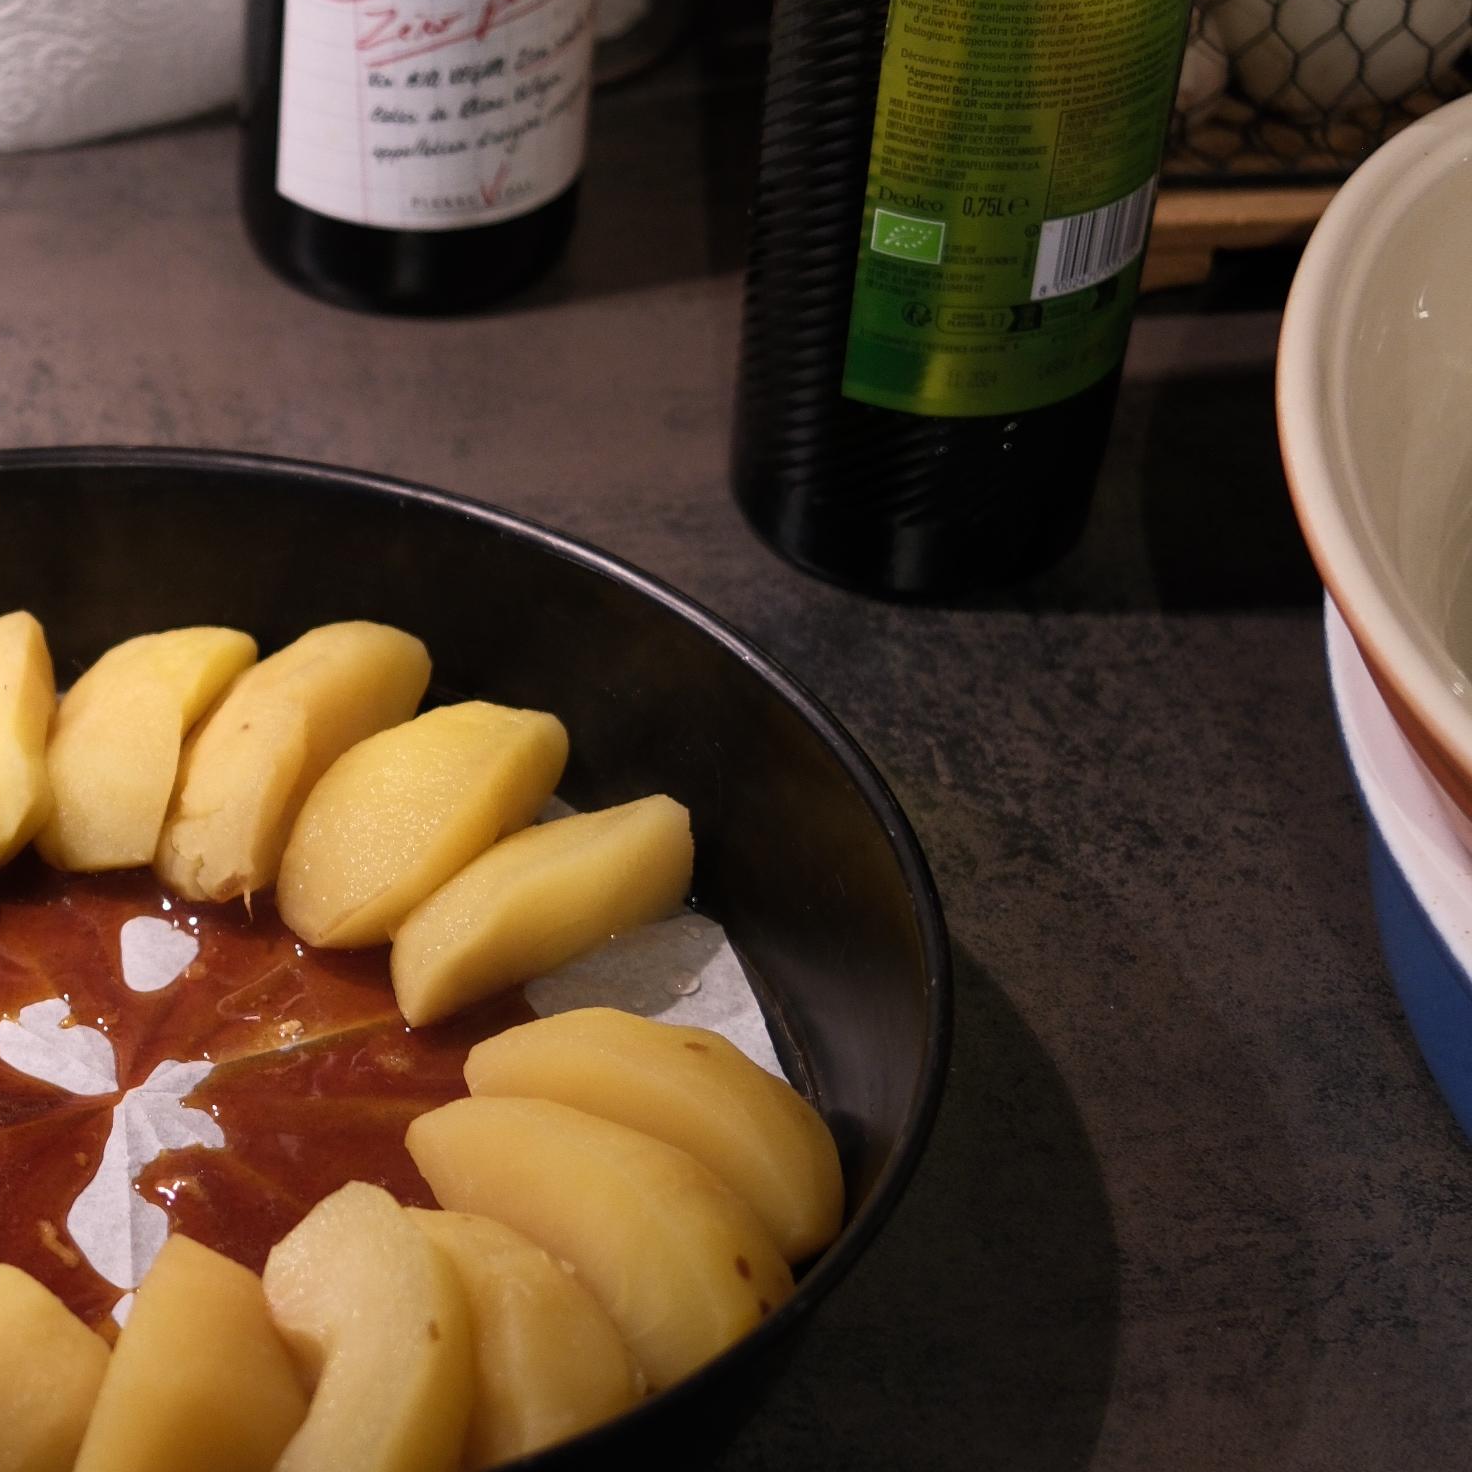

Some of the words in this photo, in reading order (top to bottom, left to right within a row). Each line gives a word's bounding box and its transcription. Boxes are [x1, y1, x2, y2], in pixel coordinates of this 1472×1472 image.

[931, 5, 958, 18] Extra
[979, 2, 998, 11] son
[1059, 1, 1082, 13] pour
[903, 23, 956, 43] biologique,
[958, 37, 1009, 49] apportera
[1011, 39, 1024, 48] de
[912, 15, 945, 29] d'olive
[947, 20, 979, 35] Vierge
[980, 24, 1009, 36] Extra
[1010, 25, 1056, 38] Carapelli
[1058, 24, 1075, 35] Bio
[901, 47, 951, 68] Découvrez
[953, 61, 981, 71] notre
[907, 77, 950, 94] Carapelli
[952, 85, 970, 97] Bio
[971, 86, 1011, 99] Delicato
[971, 77, 993, 87] plus
[907, 90, 950, 105] scannant
[963, 98, 978, 108] QR
[979, 101, 1002, 110] code
[879, 185, 945, 213] Deoleo
[962, 196, 1005, 218] 0,75L
